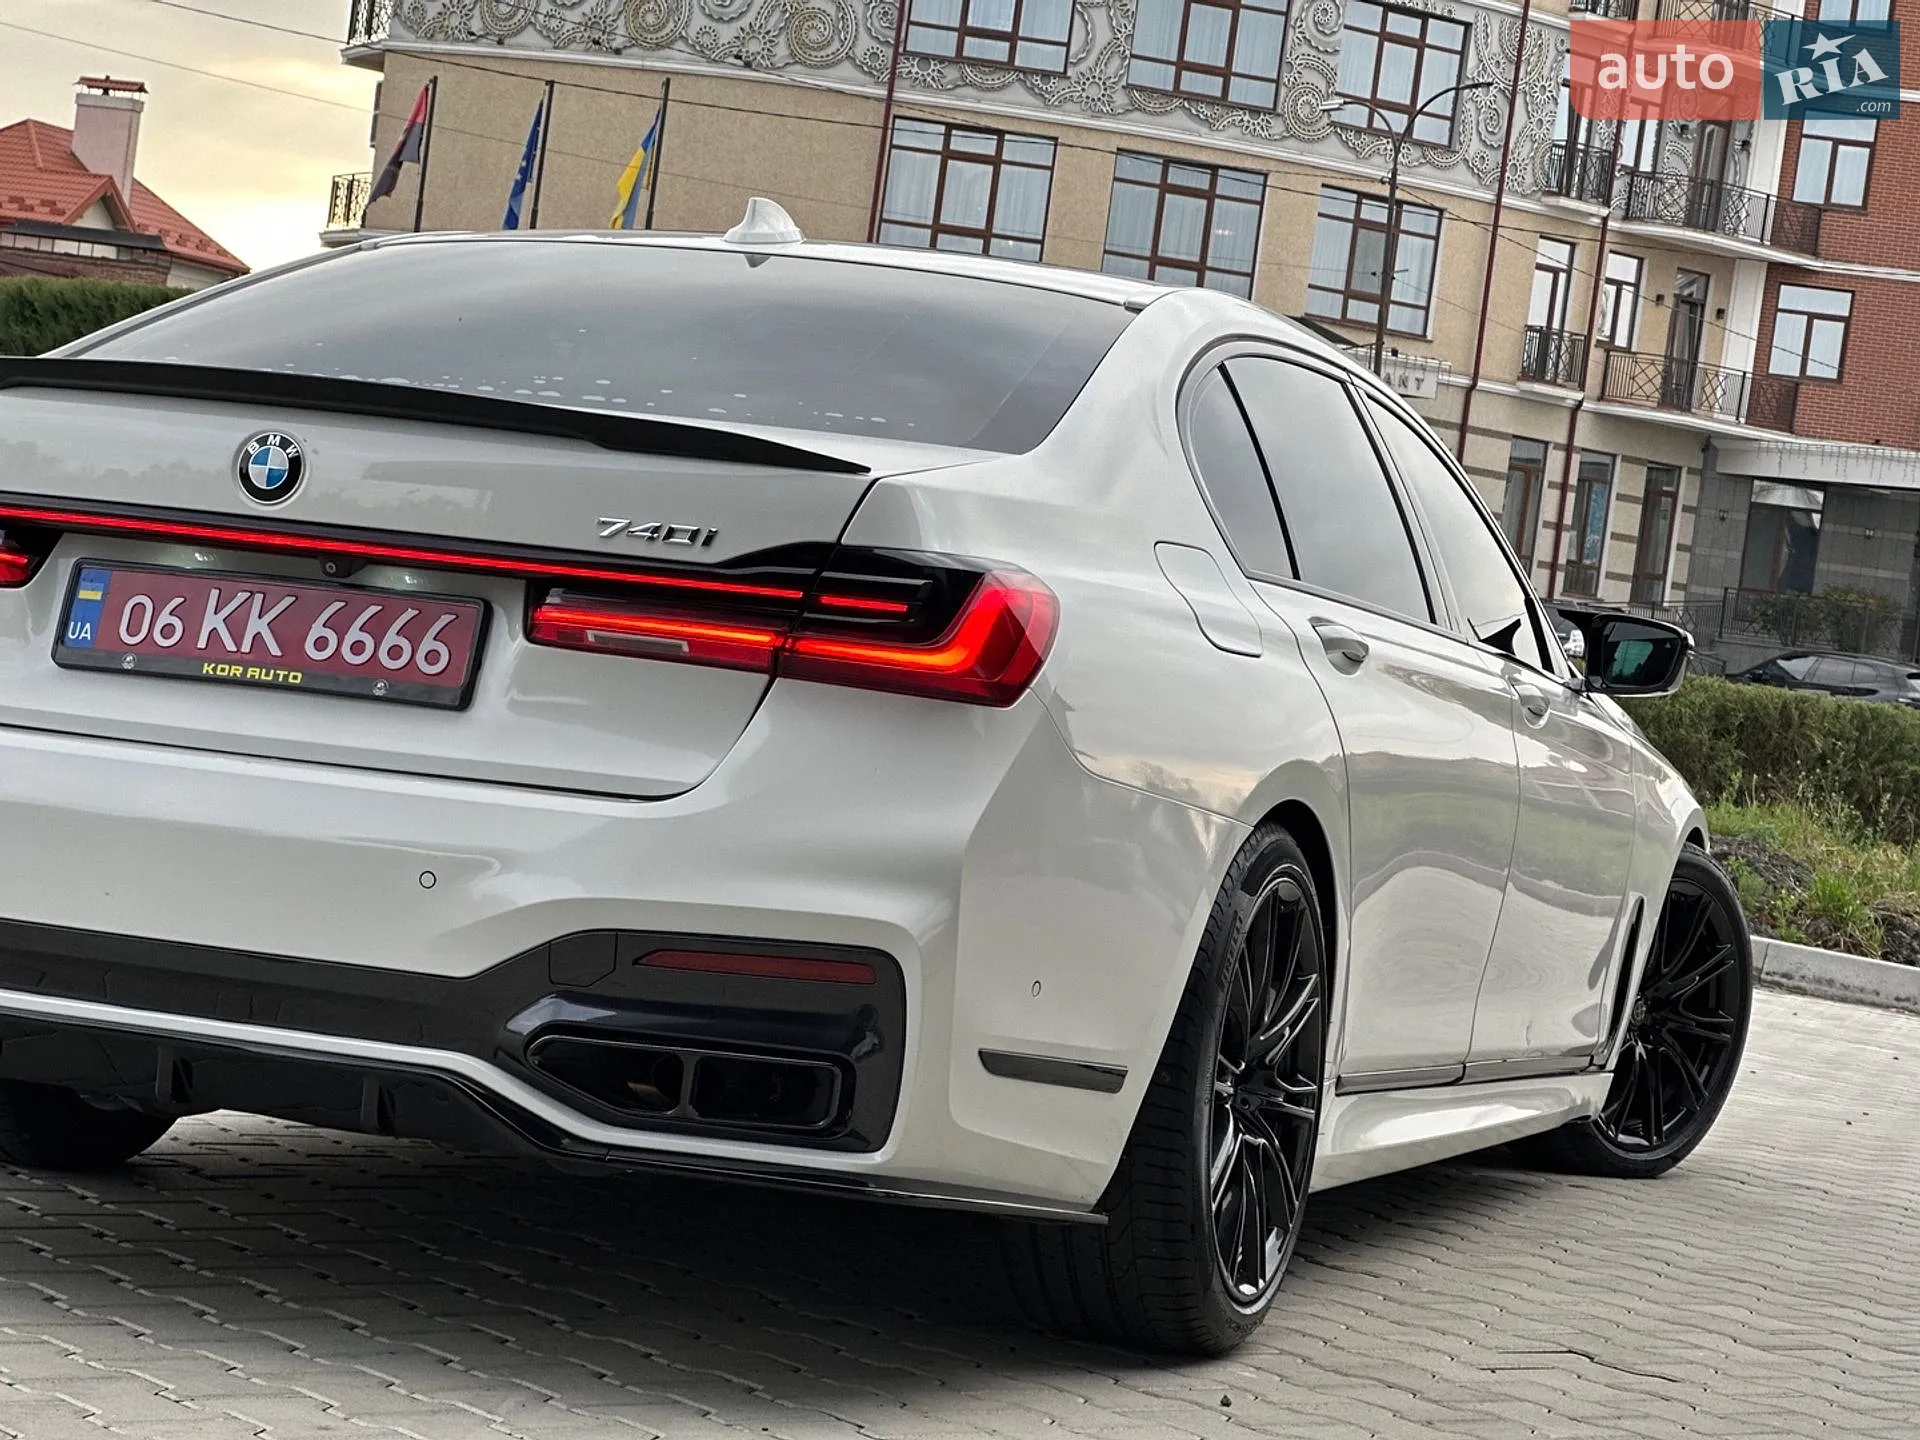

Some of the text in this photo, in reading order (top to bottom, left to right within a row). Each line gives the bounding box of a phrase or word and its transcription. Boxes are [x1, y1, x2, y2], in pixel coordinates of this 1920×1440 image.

[247, 434, 300, 459] BMW
[597, 517, 718, 547] 740i
[68, 621, 92, 641] UA
[118, 587, 458, 676] 06 KK 6666
[202, 661, 303, 685] KOR AUTO
